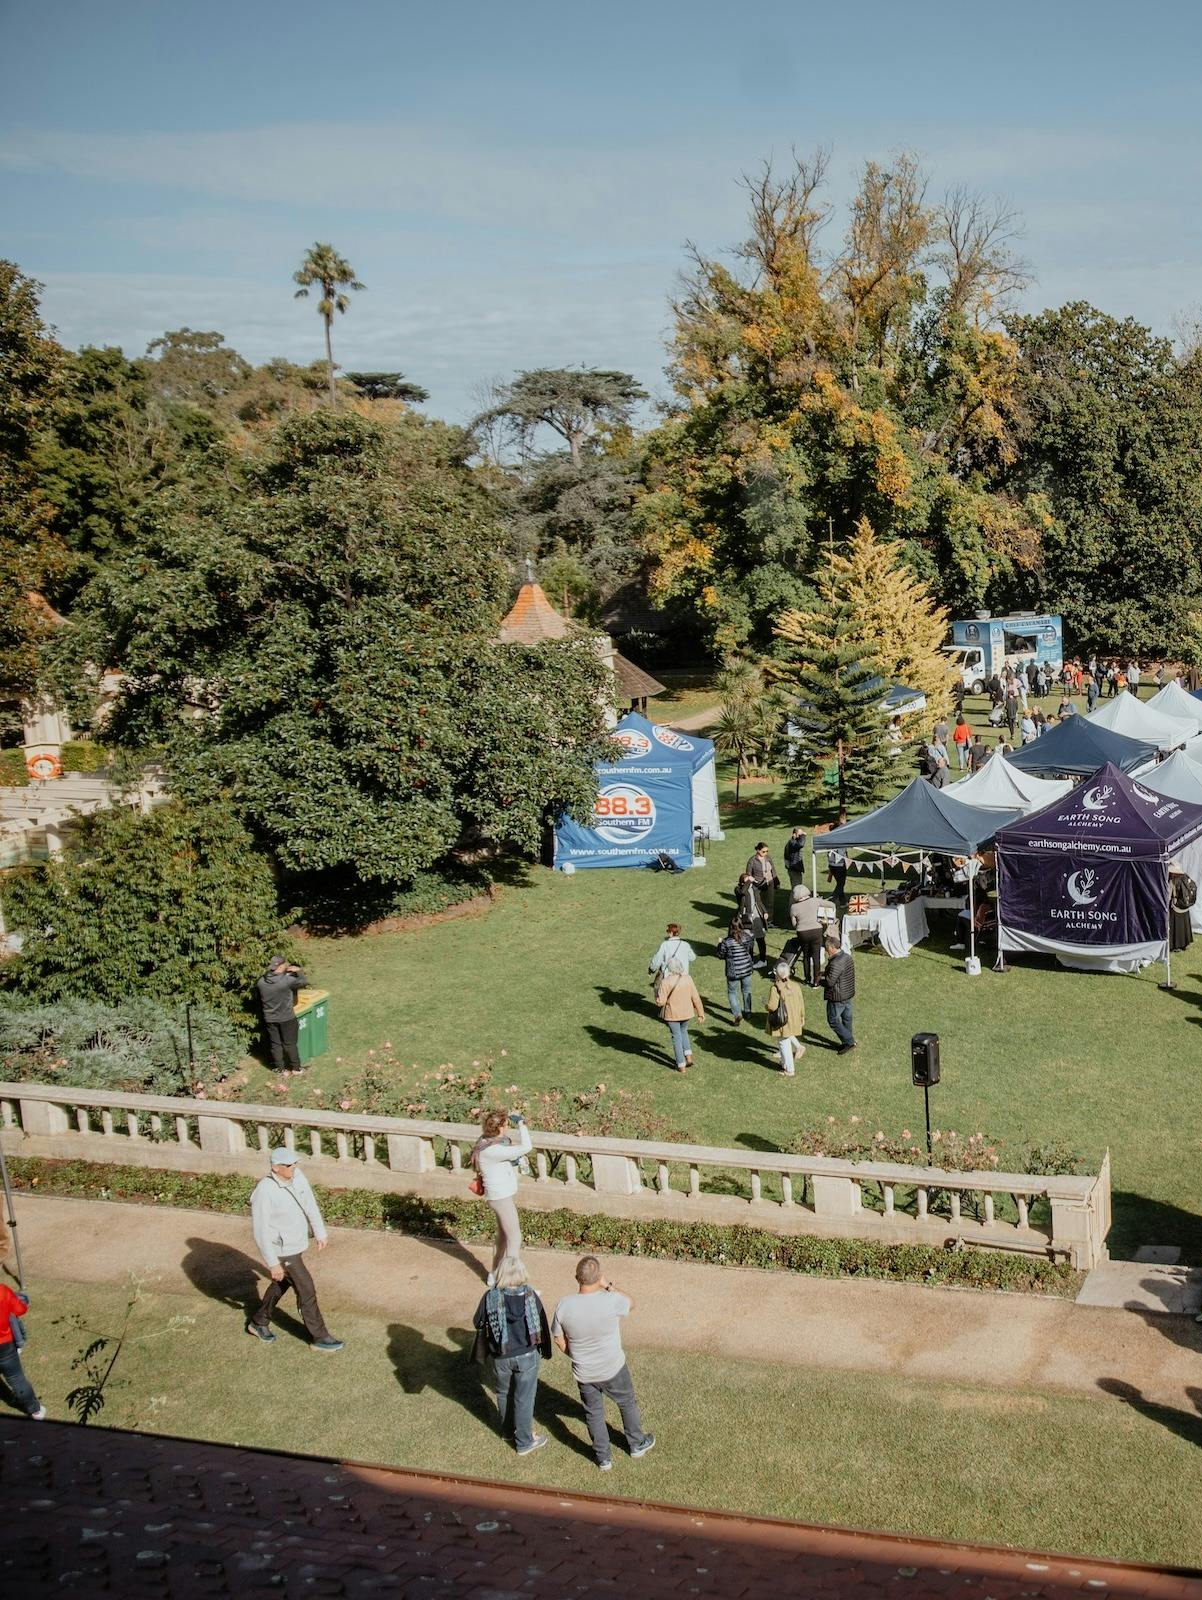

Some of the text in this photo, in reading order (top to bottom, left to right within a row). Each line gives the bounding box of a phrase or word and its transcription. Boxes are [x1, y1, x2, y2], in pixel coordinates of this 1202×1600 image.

[595, 797, 651, 815] 88.3
[598, 818, 650, 826] Southern FM
[1057, 813, 1121, 824] EARTH SONG
[1028, 839, 1132, 853] earthsongalchemy.com.au
[1050, 908, 1117, 922] EARTH SONG
[1065, 922, 1103, 930] ALCHEMY
